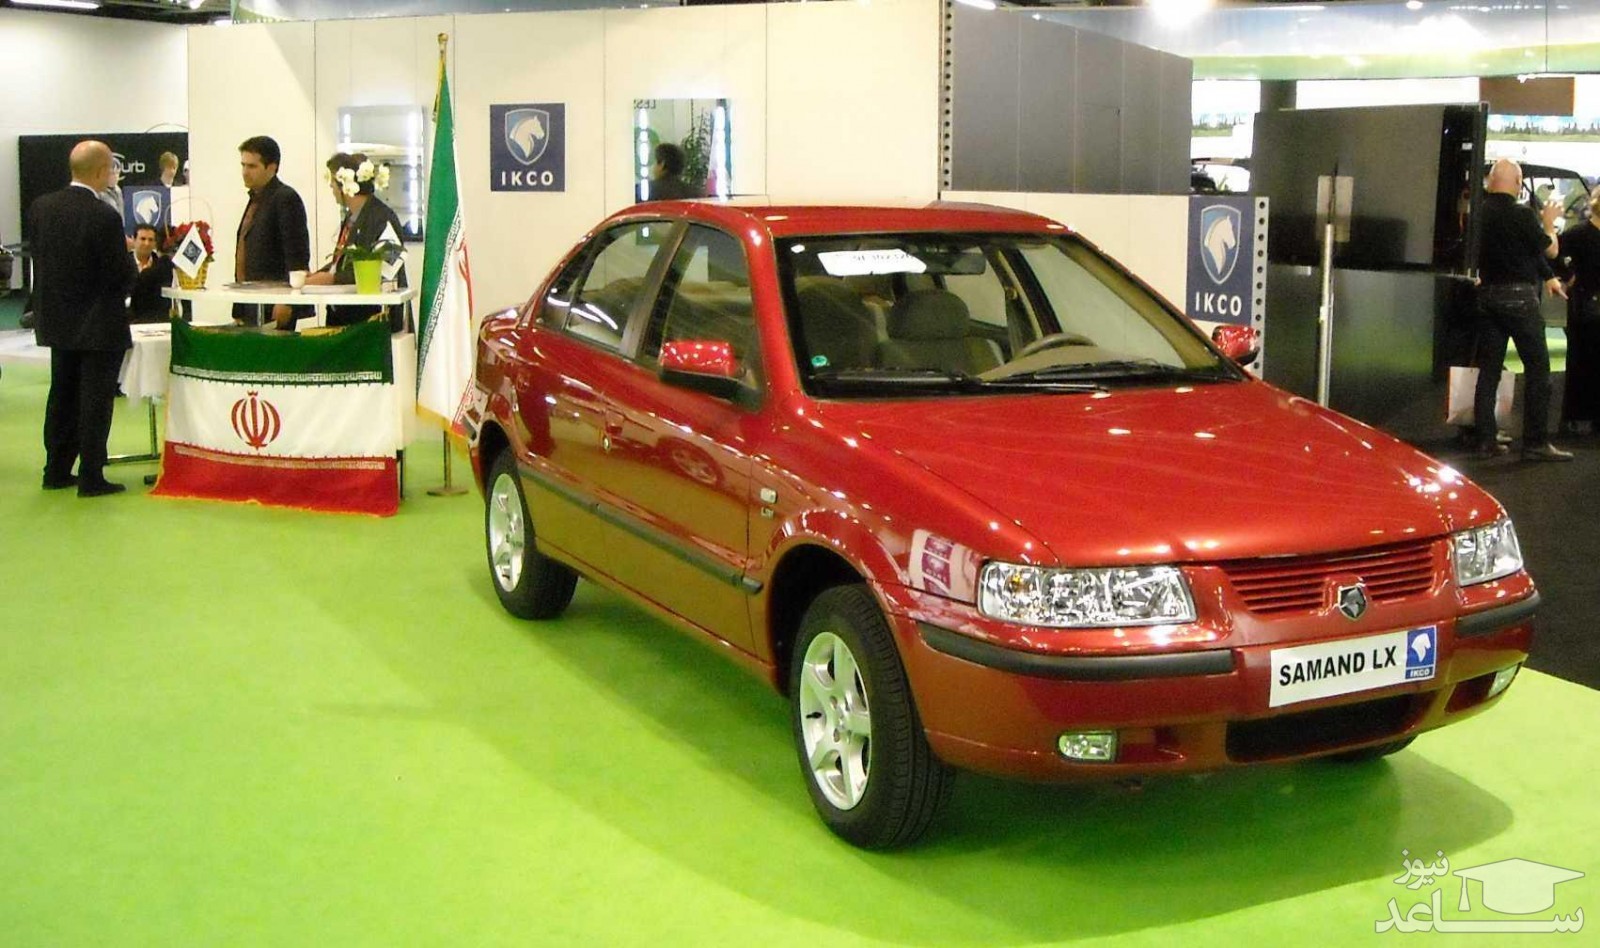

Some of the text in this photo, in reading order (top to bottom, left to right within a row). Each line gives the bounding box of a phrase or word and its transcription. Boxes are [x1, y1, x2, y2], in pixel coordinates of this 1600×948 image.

[501, 171, 554, 186] IKCO
[1195, 291, 1242, 317] IKCO
[1279, 645, 1397, 686] SAMAND LX
[1410, 668, 1430, 678] IKCO
